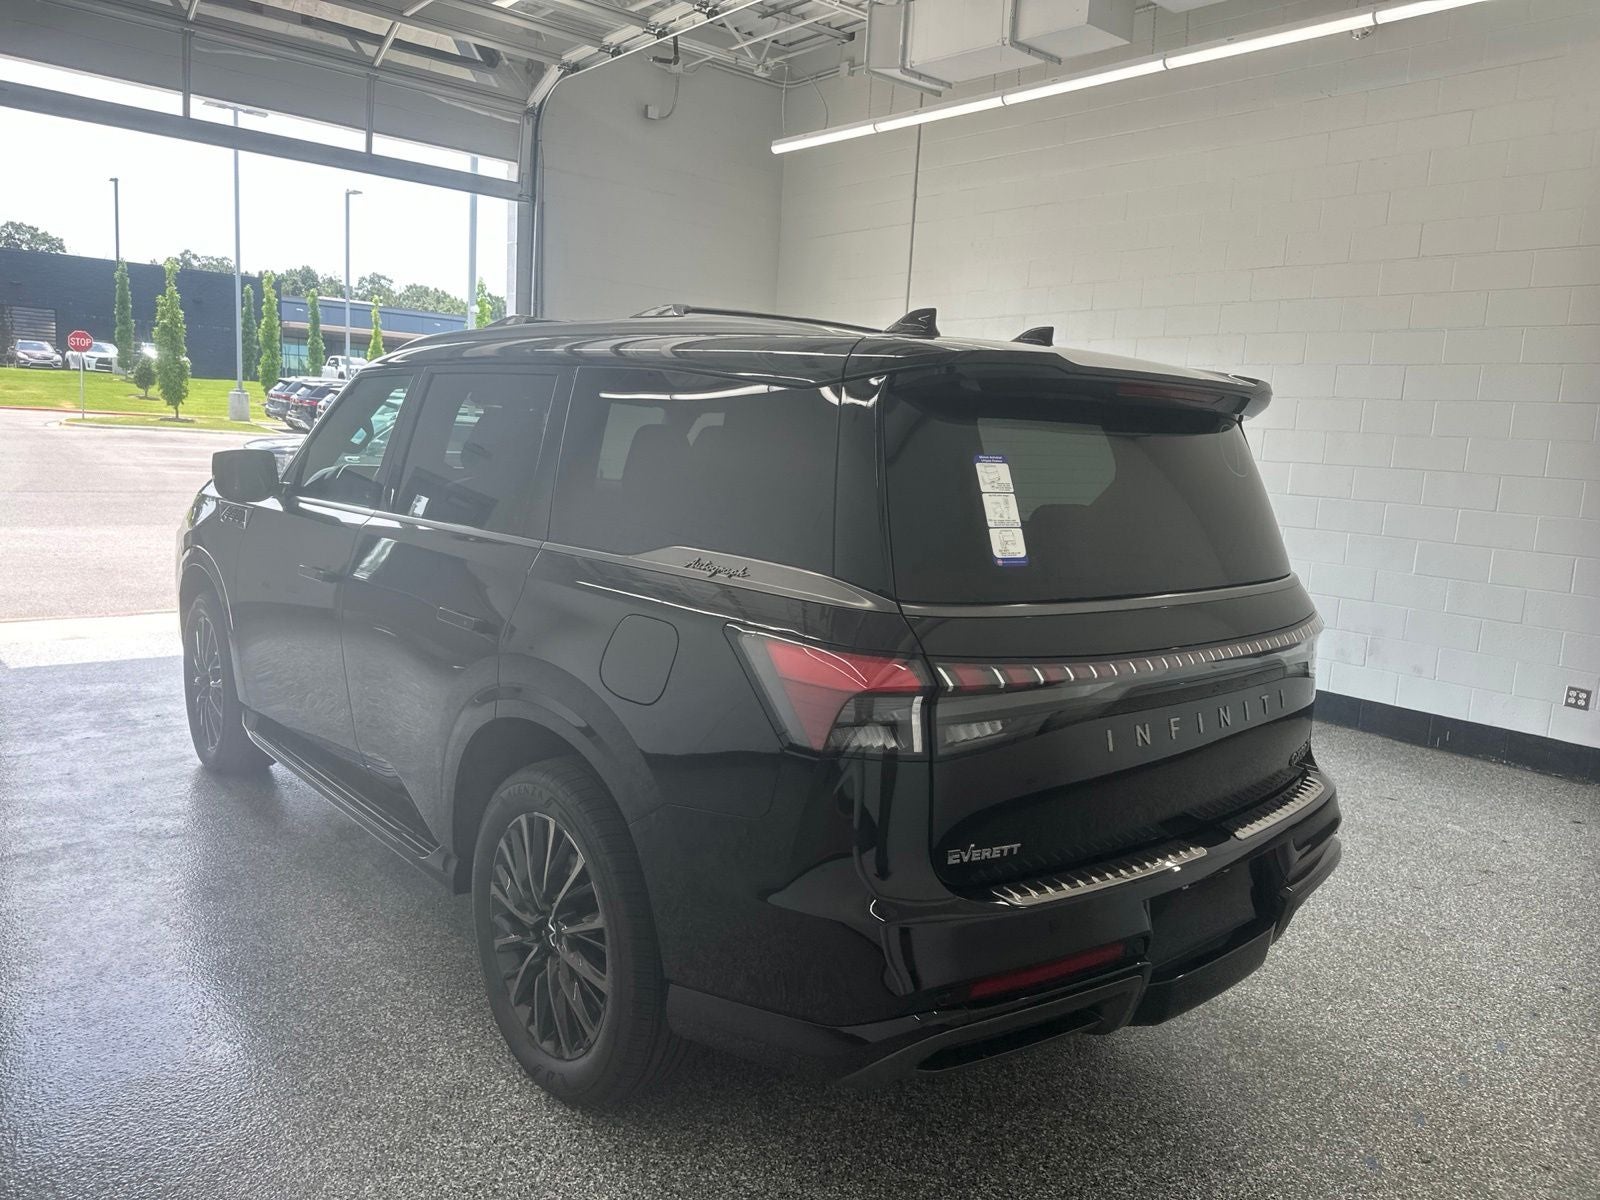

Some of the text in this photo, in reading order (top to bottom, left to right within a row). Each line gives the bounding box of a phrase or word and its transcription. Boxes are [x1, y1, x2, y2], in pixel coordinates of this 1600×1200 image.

[70, 337, 91, 346] STOP
[684, 557, 751, 578] Autograph
[1106, 689, 1285, 752] INFINITI
[947, 843, 1021, 865] EVERETT
